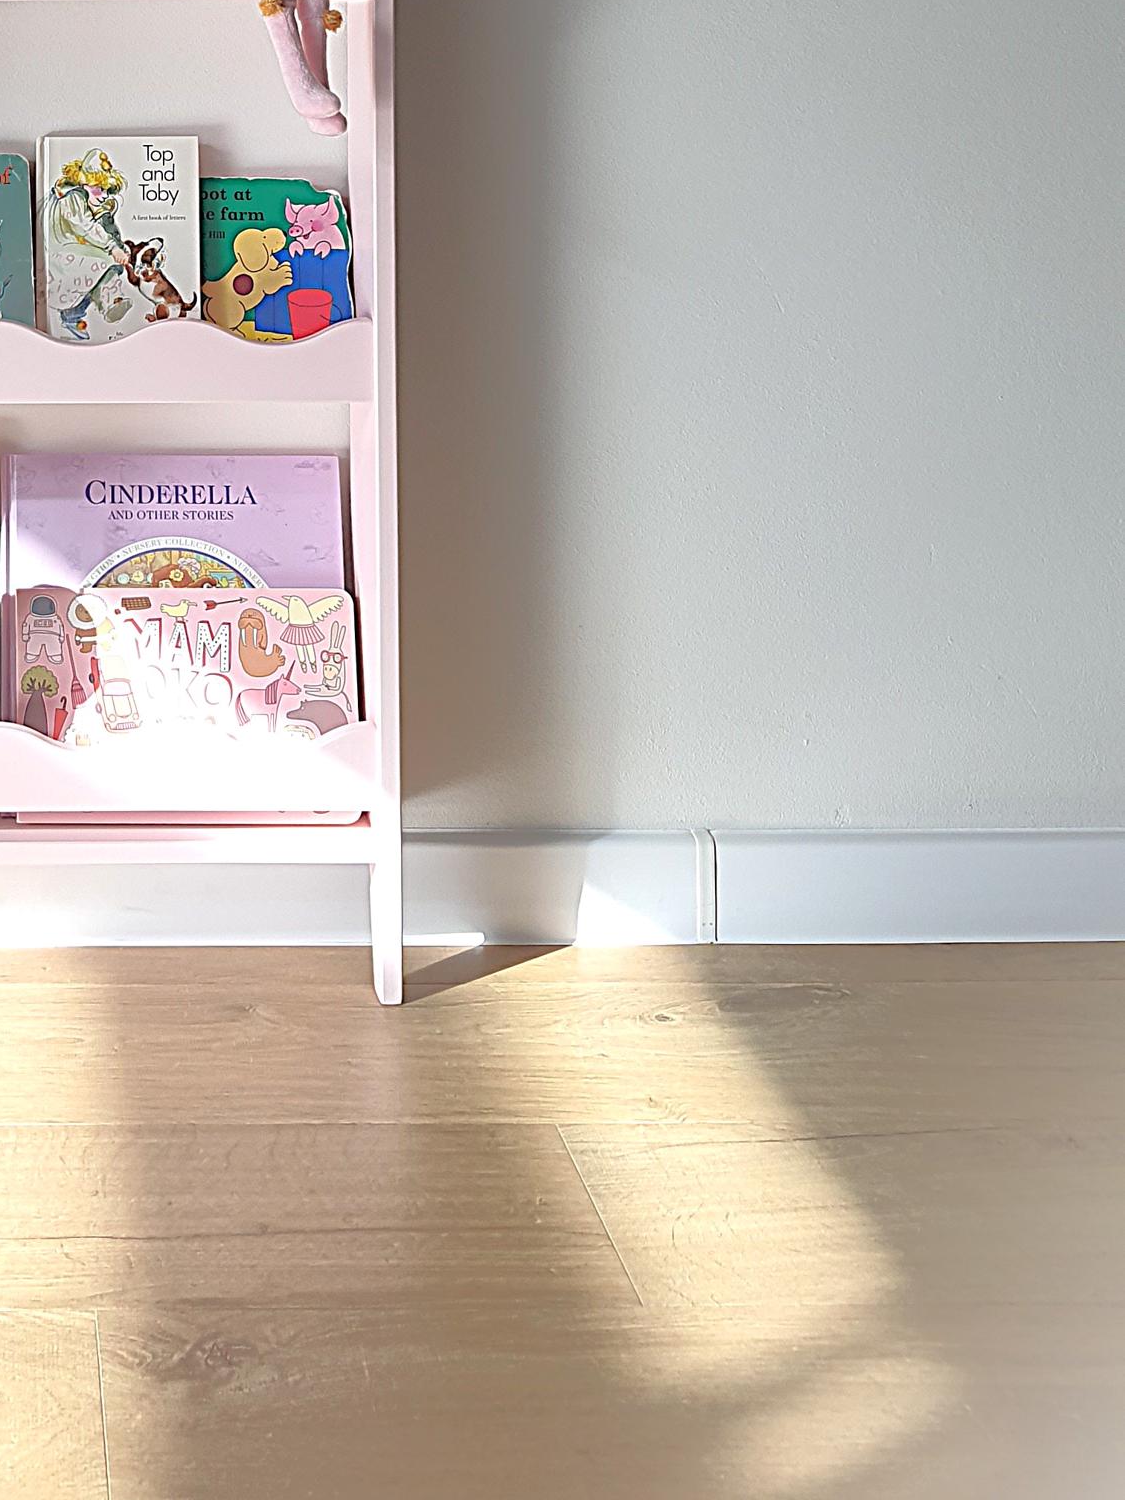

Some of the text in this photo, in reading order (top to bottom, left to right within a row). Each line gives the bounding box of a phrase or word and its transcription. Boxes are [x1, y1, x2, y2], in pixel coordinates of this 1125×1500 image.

[142, 144, 174, 166] Top
[141, 163, 175, 182] and
[138, 182, 179, 206] Toby
[234, 188, 253, 201] at
[220, 206, 265, 221] farm
[85, 479, 258, 505] CINDERELLA
[107, 509, 234, 520] AND OTHER STORIES
